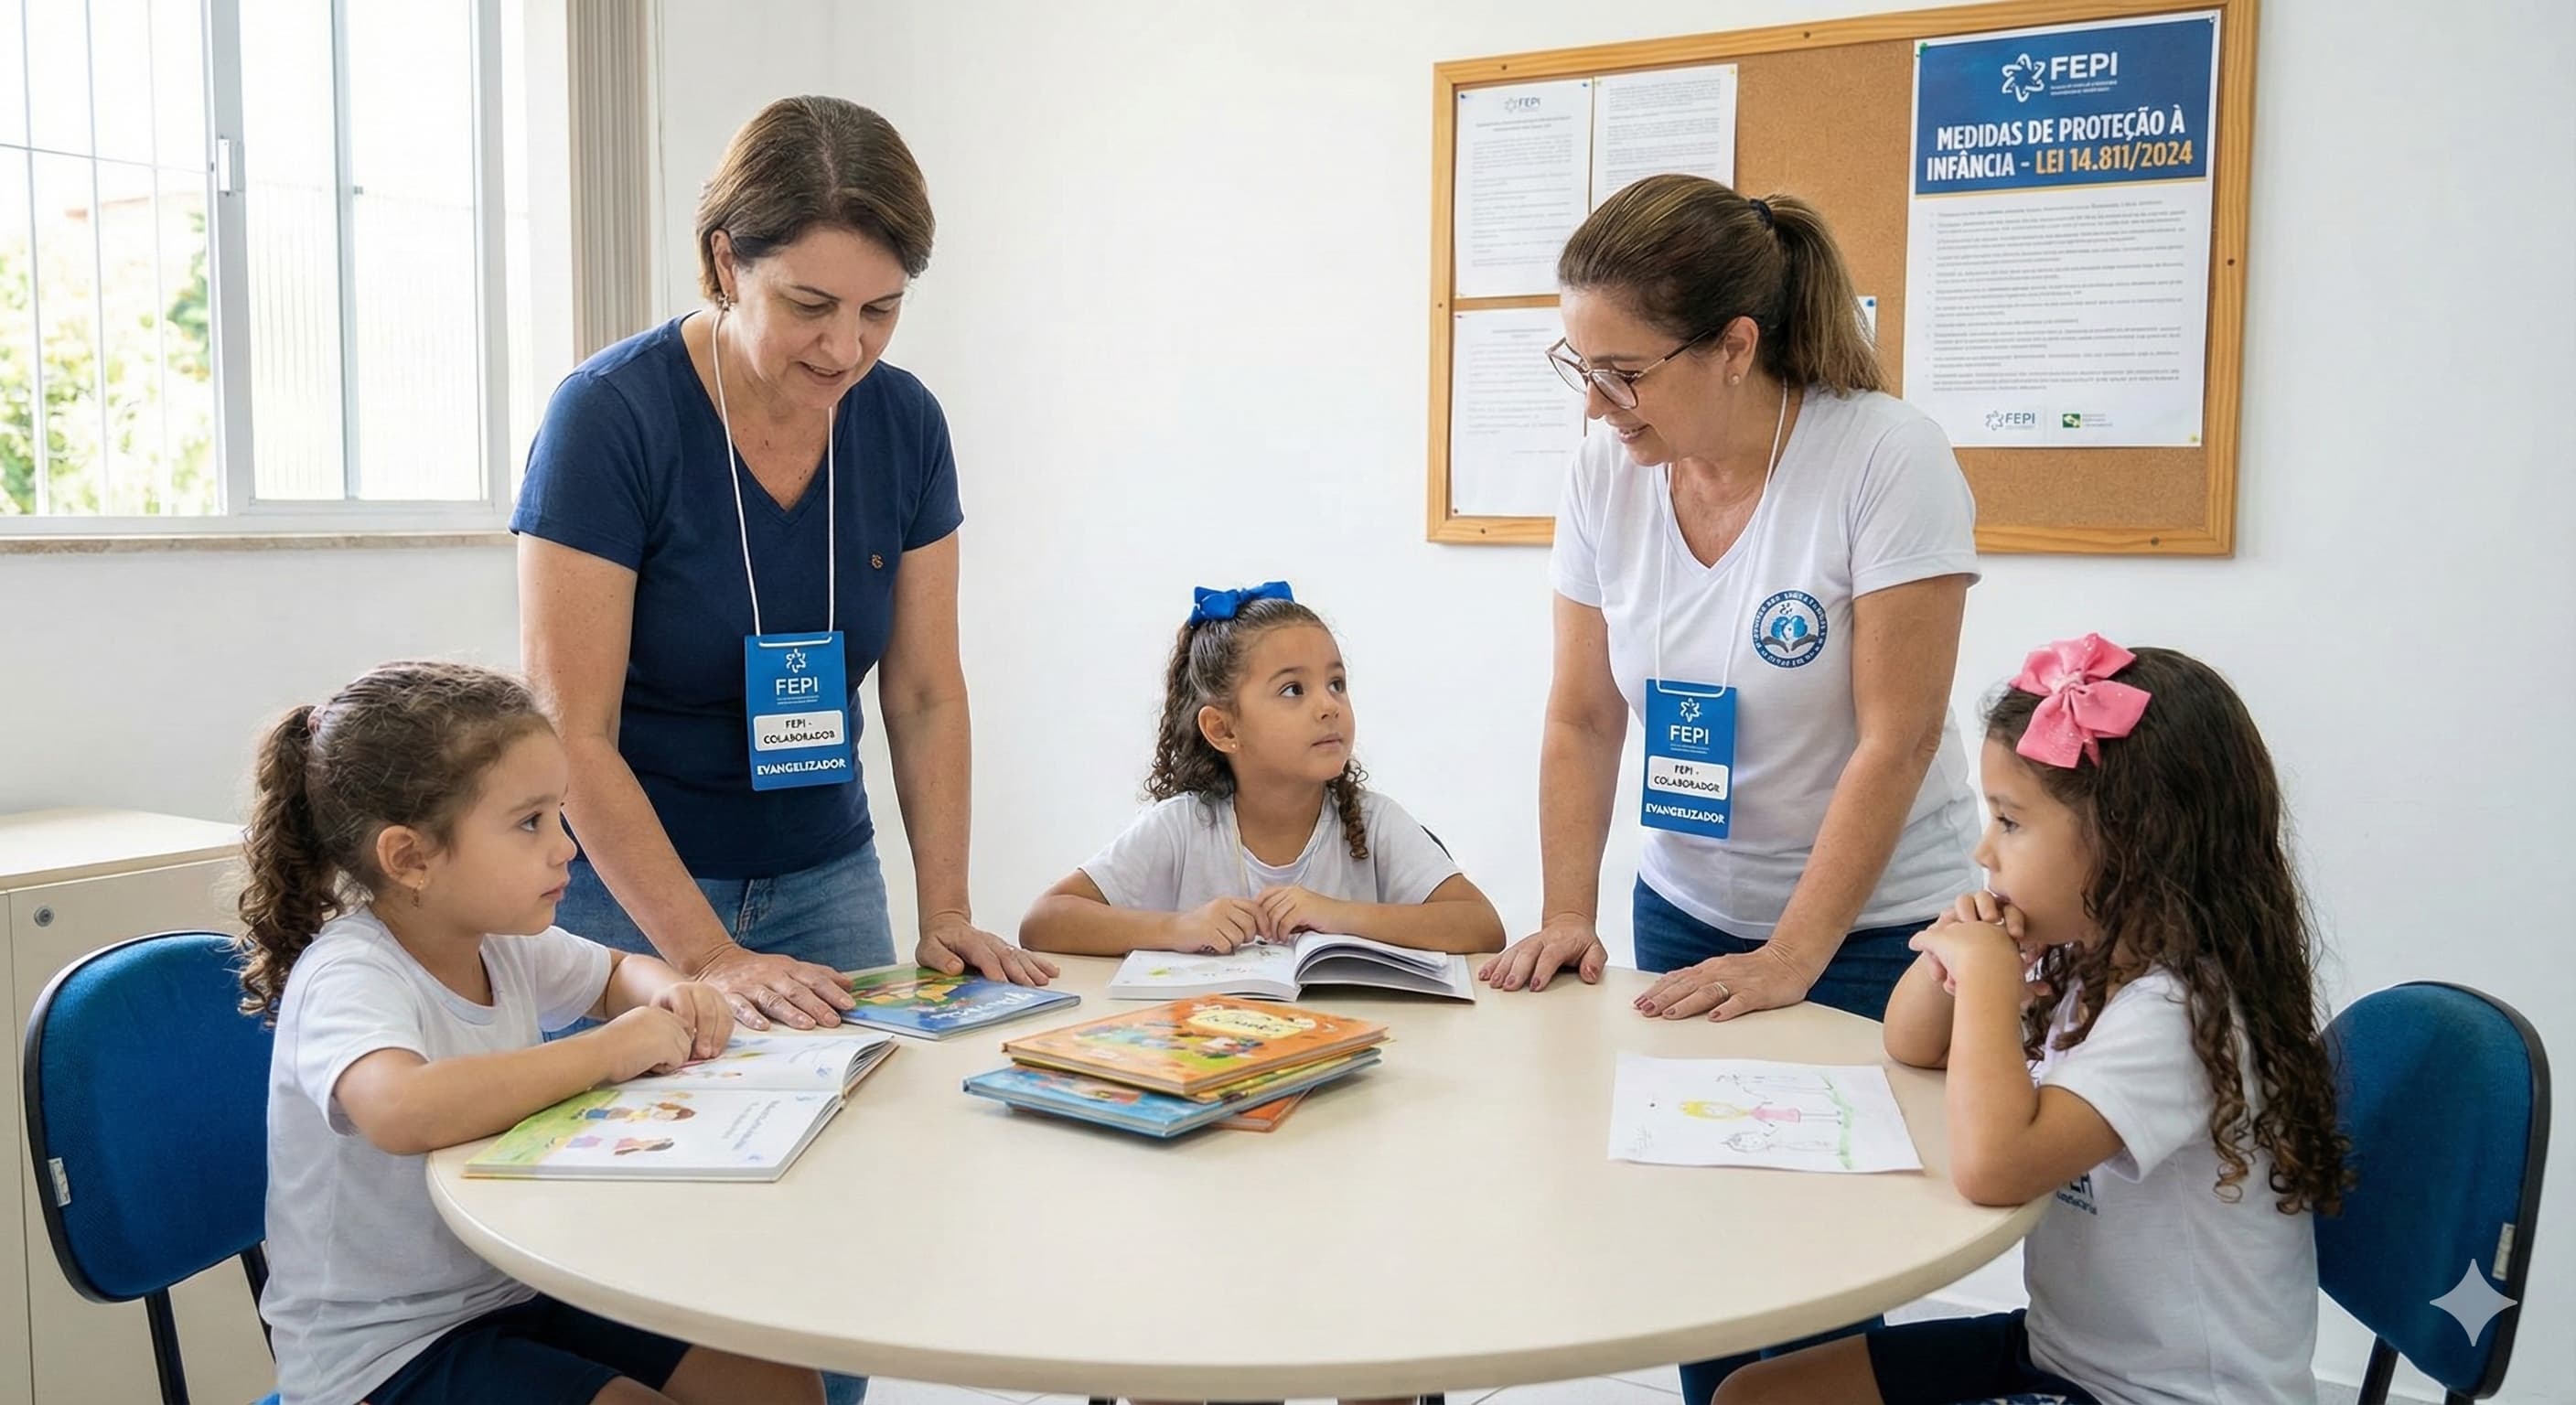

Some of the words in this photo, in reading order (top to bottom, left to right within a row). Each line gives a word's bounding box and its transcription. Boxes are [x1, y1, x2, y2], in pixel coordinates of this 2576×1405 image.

[2050, 51, 2119, 81] FEPI
[1937, 122, 2023, 151] MEDIDAS
[2027, 120, 2054, 145] DE
[2059, 107, 2164, 143] PROTEÇÃO
[2170, 104, 2186, 134] À
[1927, 151, 2015, 181] INFÂNCIA
[2035, 149, 2065, 175] LEI
[2070, 140, 2194, 173] 14.811/2024
[2005, 413, 2035, 424] FEPI
[776, 677, 819, 696] FEPI
[785, 719, 806, 729] FEPI
[1669, 724, 1710, 745] FEPI
[757, 758, 846, 776] EVANGELIZADOR
[1674, 765, 1693, 775] FEPI
[1646, 802, 1726, 824] EVANGELIZADOR
